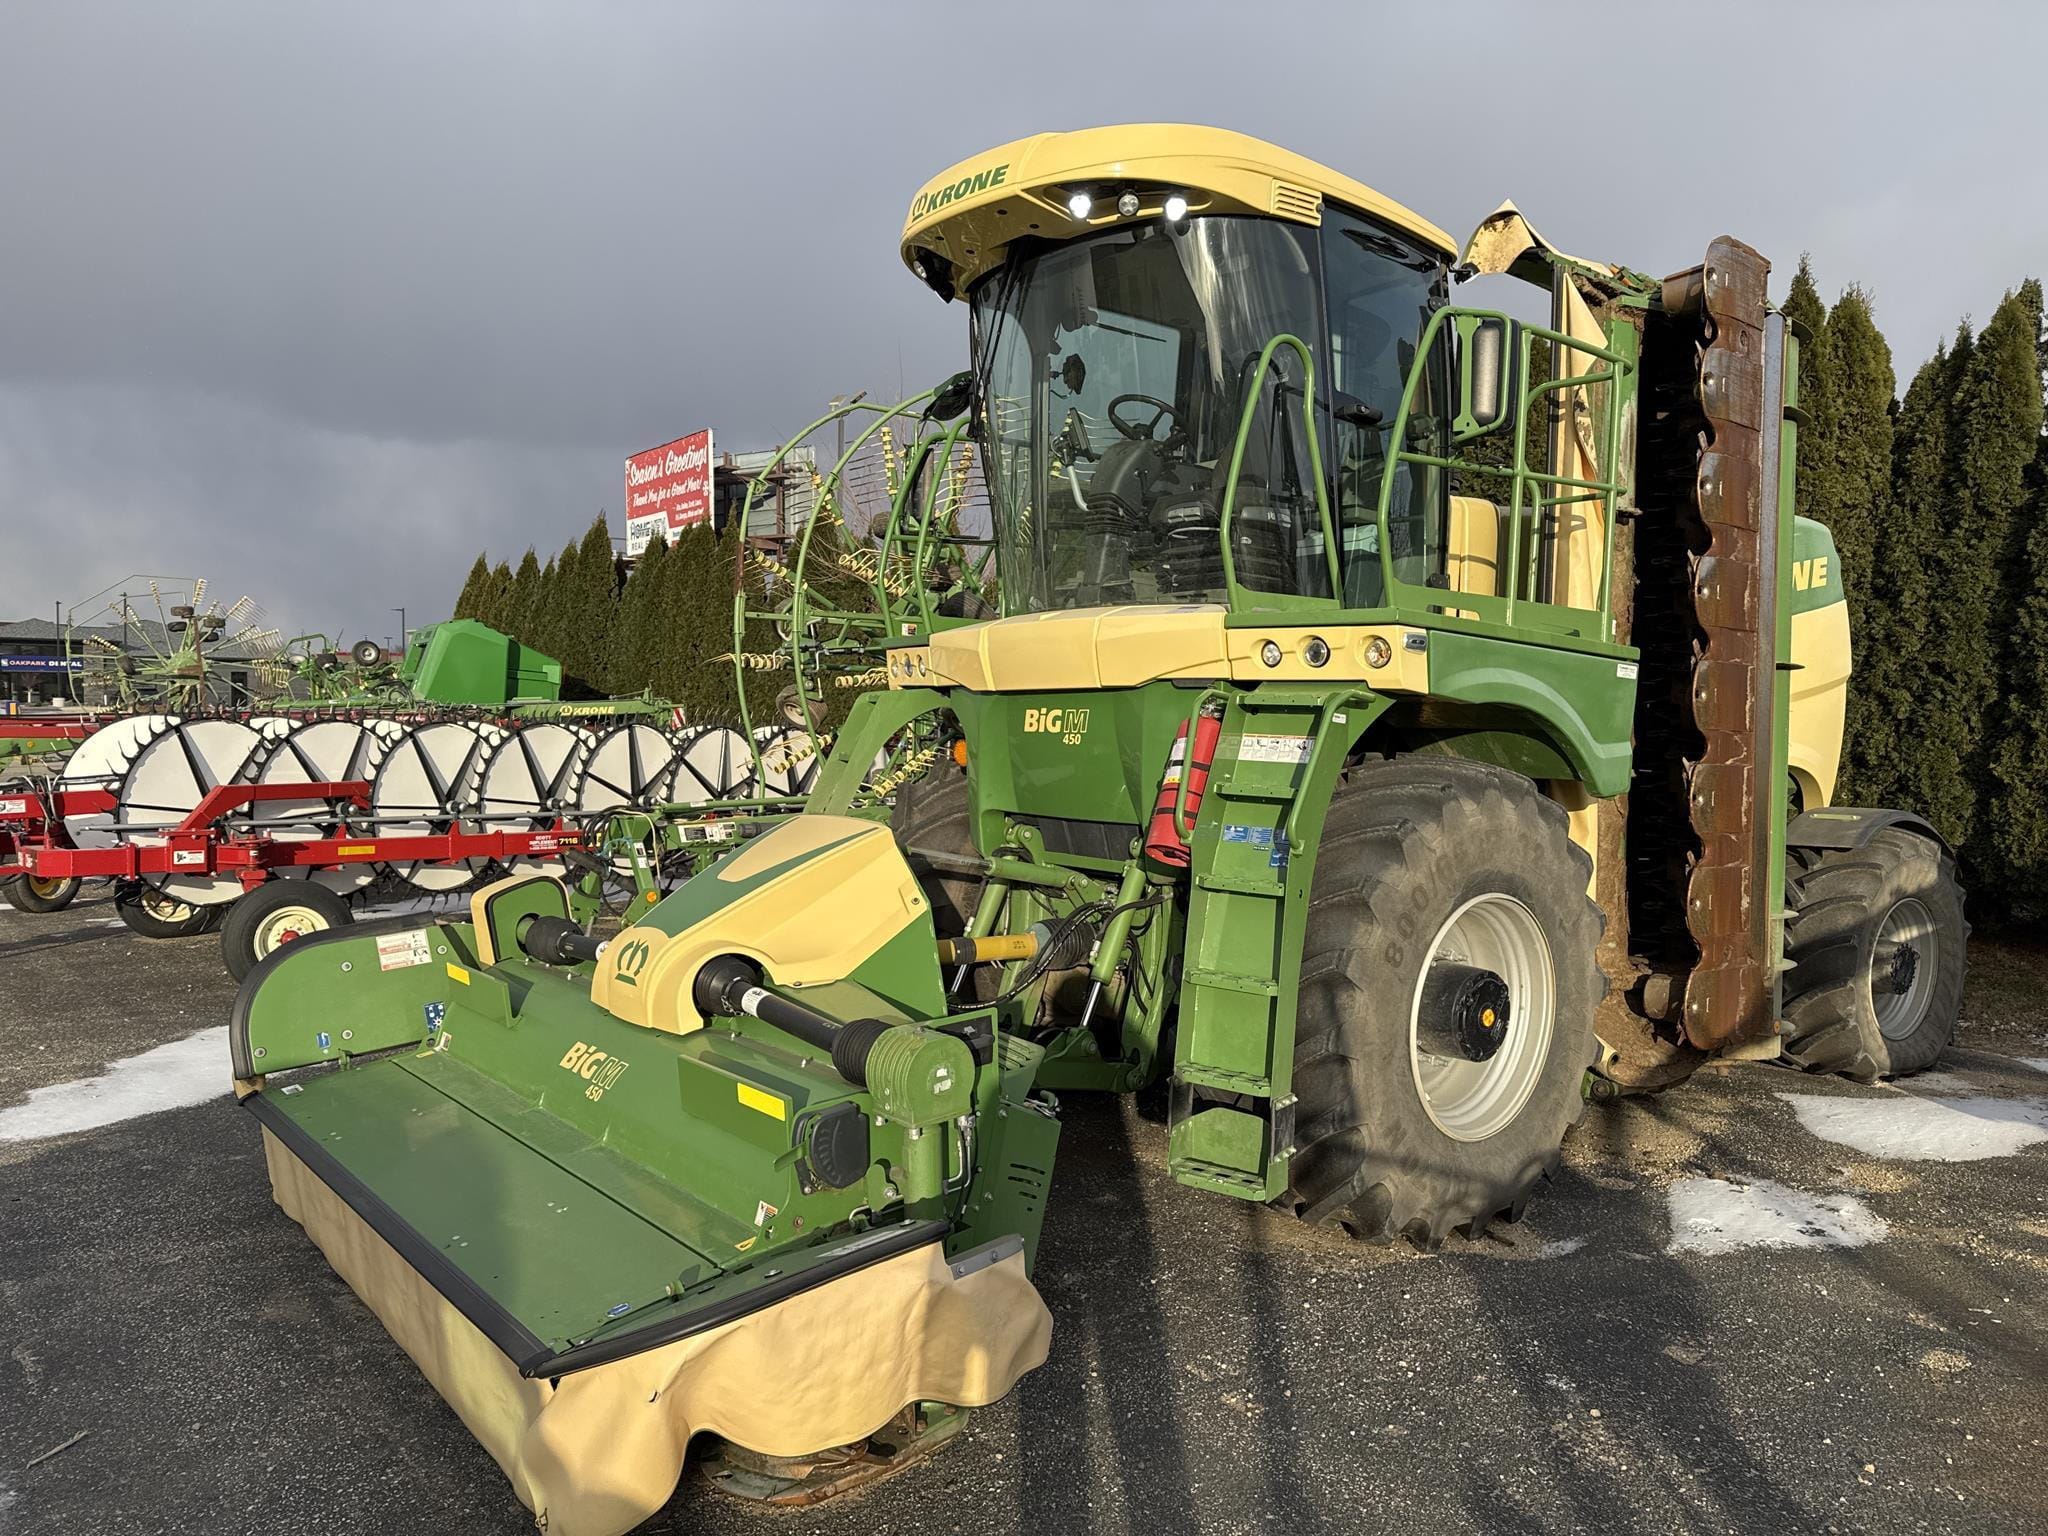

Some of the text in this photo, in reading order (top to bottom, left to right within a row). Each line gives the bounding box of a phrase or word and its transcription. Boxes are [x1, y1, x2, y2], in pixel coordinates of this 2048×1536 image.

[926, 164, 1010, 213] KRONE
[629, 444, 708, 487] Season's Greetings
[573, 706, 615, 715] KRONE
[1062, 734, 1081, 745] 450
[585, 1084, 603, 1102] 450
